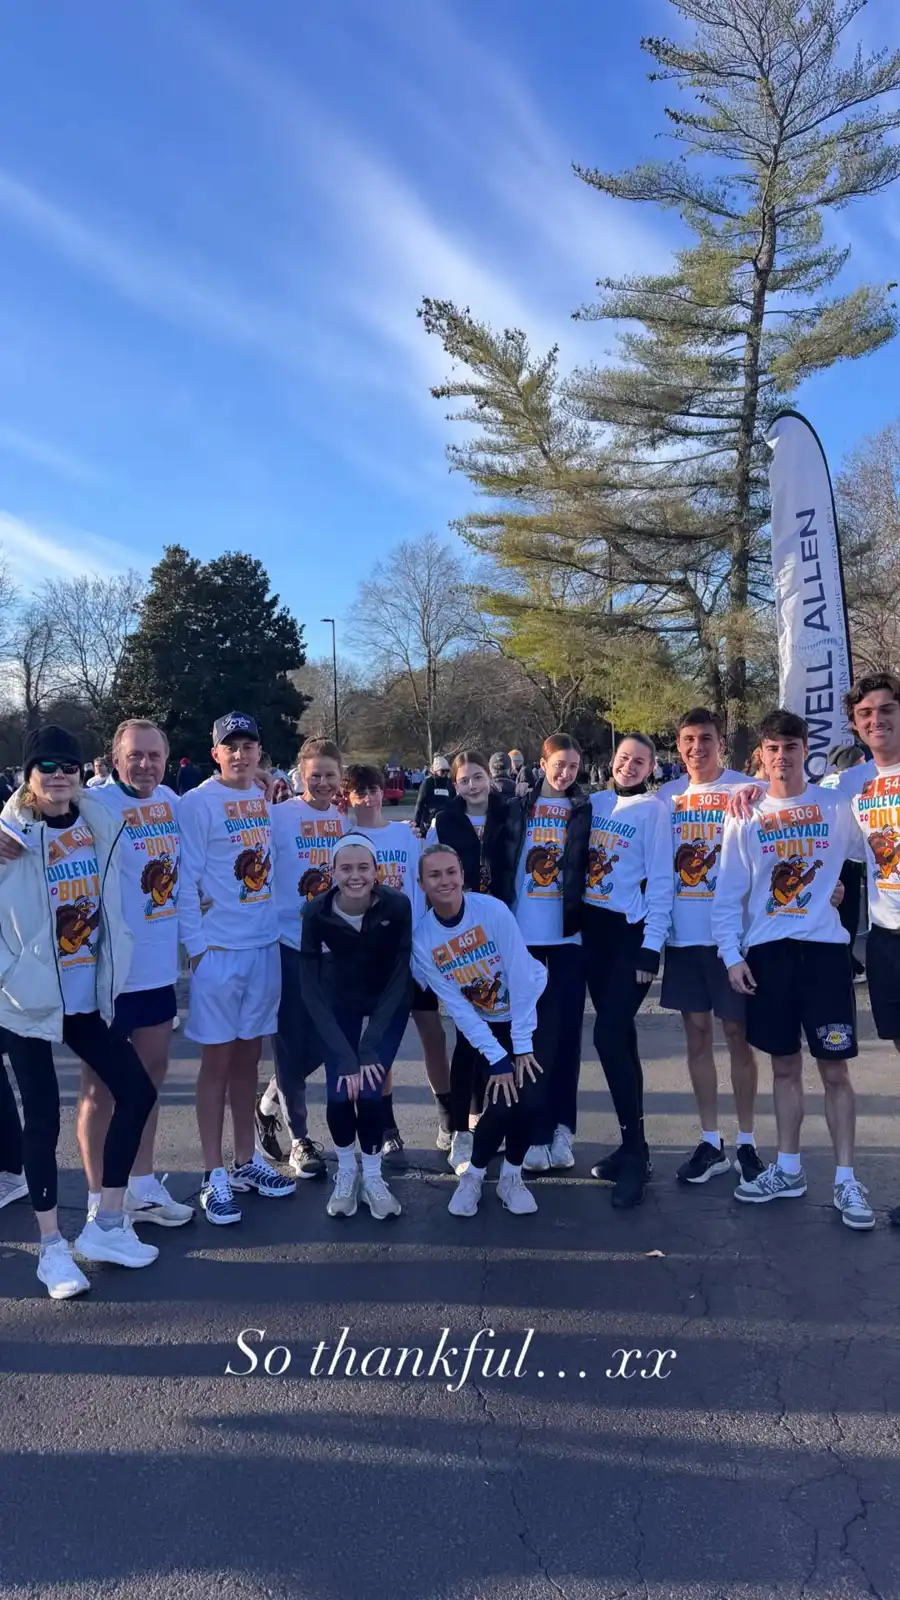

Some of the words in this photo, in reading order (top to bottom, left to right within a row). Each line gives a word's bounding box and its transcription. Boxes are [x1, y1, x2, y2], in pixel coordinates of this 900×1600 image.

[796, 508, 830, 632] ALLEN
[803, 650, 834, 784] OWELL
[246, 801, 262, 813] 439
[698, 794, 720, 806] 305
[858, 794, 900, 811] BOULEVA
[149, 804, 167, 818] 438
[546, 806, 567, 817] 708
[788, 807, 814, 821] 306
[527, 817, 567, 828] OULEVA
[591, 815, 637, 839] OULEVARD
[241, 827, 268, 847] BOLT
[681, 823, 716, 841] BOLT
[757, 823, 829, 843] BOULEVARD
[134, 842, 146, 851] 20
[144, 835, 176, 856] BOLT
[296, 836, 339, 849] BOULEVA
[617, 839, 629, 849] 25
[762, 845, 775, 854] 20
[775, 838, 815, 859] BOLT
[815, 840, 830, 849] 25
[376, 850, 407, 863] EVARD
[458, 929, 477, 948] 467
[437, 940, 497, 974] BOULEVARD
[453, 959, 491, 985] BOLT
